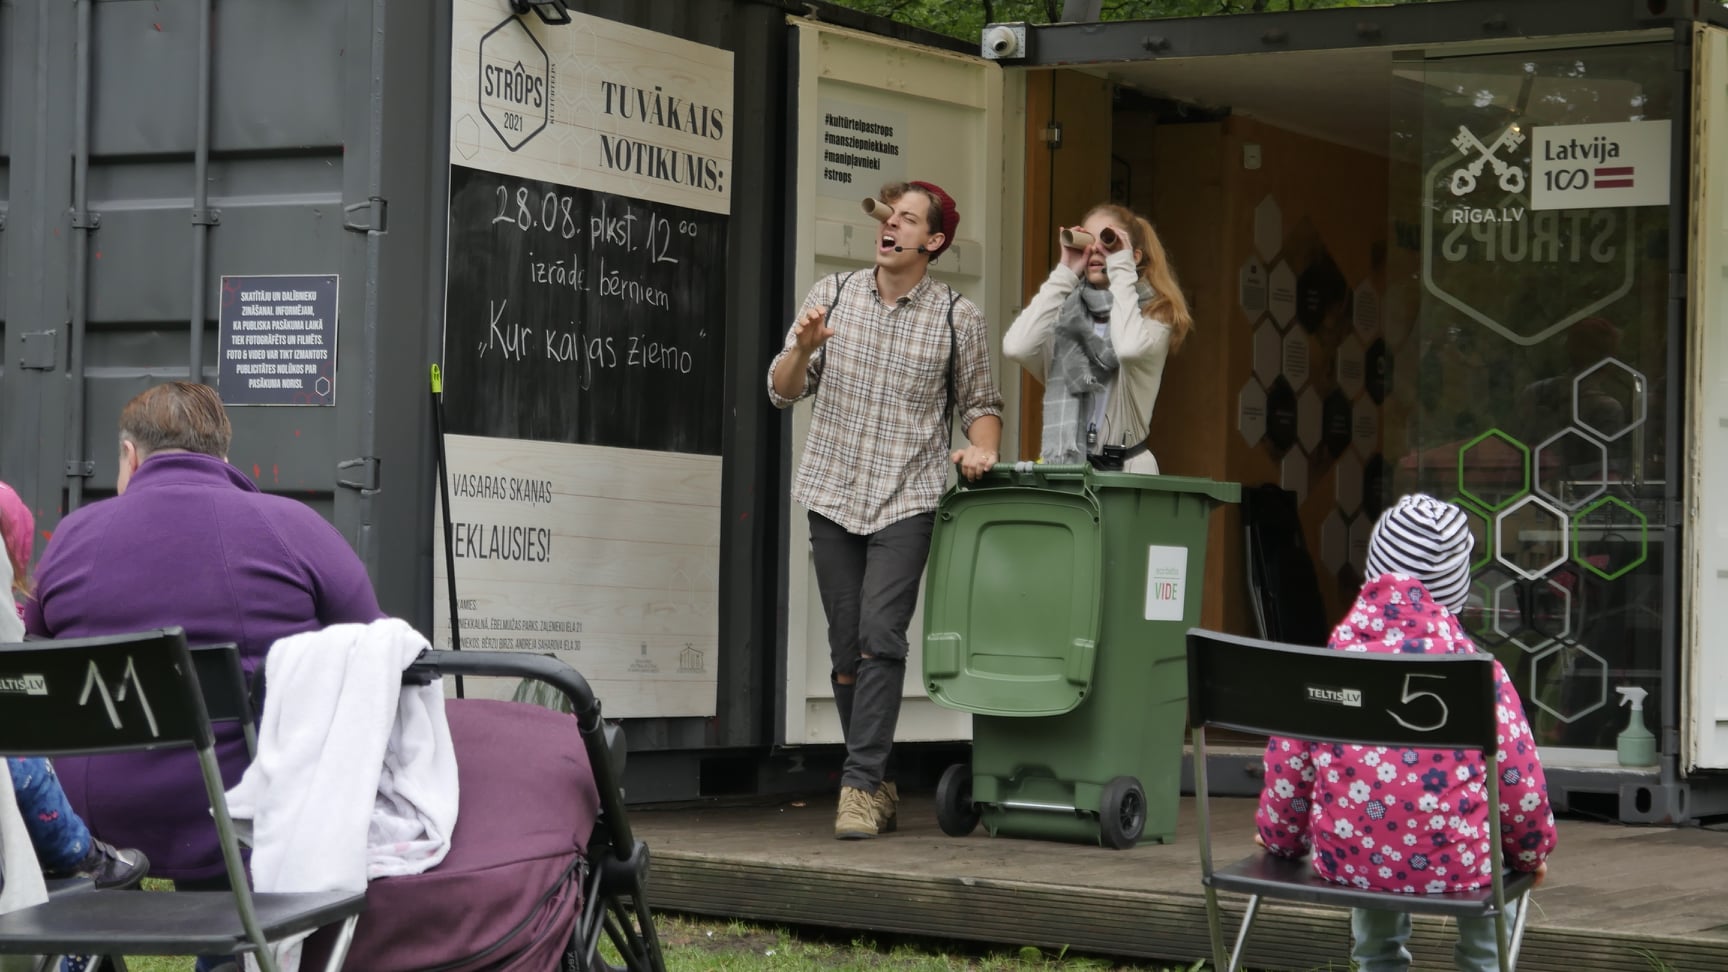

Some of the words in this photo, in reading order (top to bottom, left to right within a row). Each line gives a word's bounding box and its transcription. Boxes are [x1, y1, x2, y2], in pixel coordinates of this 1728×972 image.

[601, 80, 724, 141] TUVĀKAIS
[504, 112, 523, 133] 2021
[1544, 136, 1620, 164] Latvija
[599, 134, 724, 193] NOTIKUMS:
[824, 166, 853, 184] #strops
[492, 185, 581, 239] 28.08.
[1452, 206, 1525, 224] RĪGA.LV
[600, 256, 669, 311] bērniem
[272, 292, 281, 301] UN
[232, 321, 241, 330] KA
[242, 321, 271, 330] PUBLISKA
[272, 319, 304, 330] PASĀKUMA
[305, 319, 323, 330] LAIKĀ
[232, 335, 245, 345] TIEK
[246, 334, 287, 345] FOTOGRĀFĒTS
[288, 335, 296, 345] UN
[297, 334, 323, 345] FILMĒTS.
[226, 350, 242, 359] FOTO
[243, 350, 247, 359] &
[249, 350, 266, 359] VIDEO
[267, 350, 279, 359] VAR
[279, 350, 293, 359] TIKT
[294, 350, 328, 359] IZMANTOTS
[236, 363, 276, 374] PUBLICITĀTES
[305, 364, 317, 374] PAR
[248, 377, 281, 389] PASĀKUMA
[453, 473, 506, 500] VASARAS
[509, 477, 552, 507] SKAŅAS
[1154, 583, 1178, 600] VIDE
[0, 677, 45, 691] LTIS.LV
[1307, 687, 1361, 703] TELTIS.LV
[1385, 673, 1449, 732] 5
